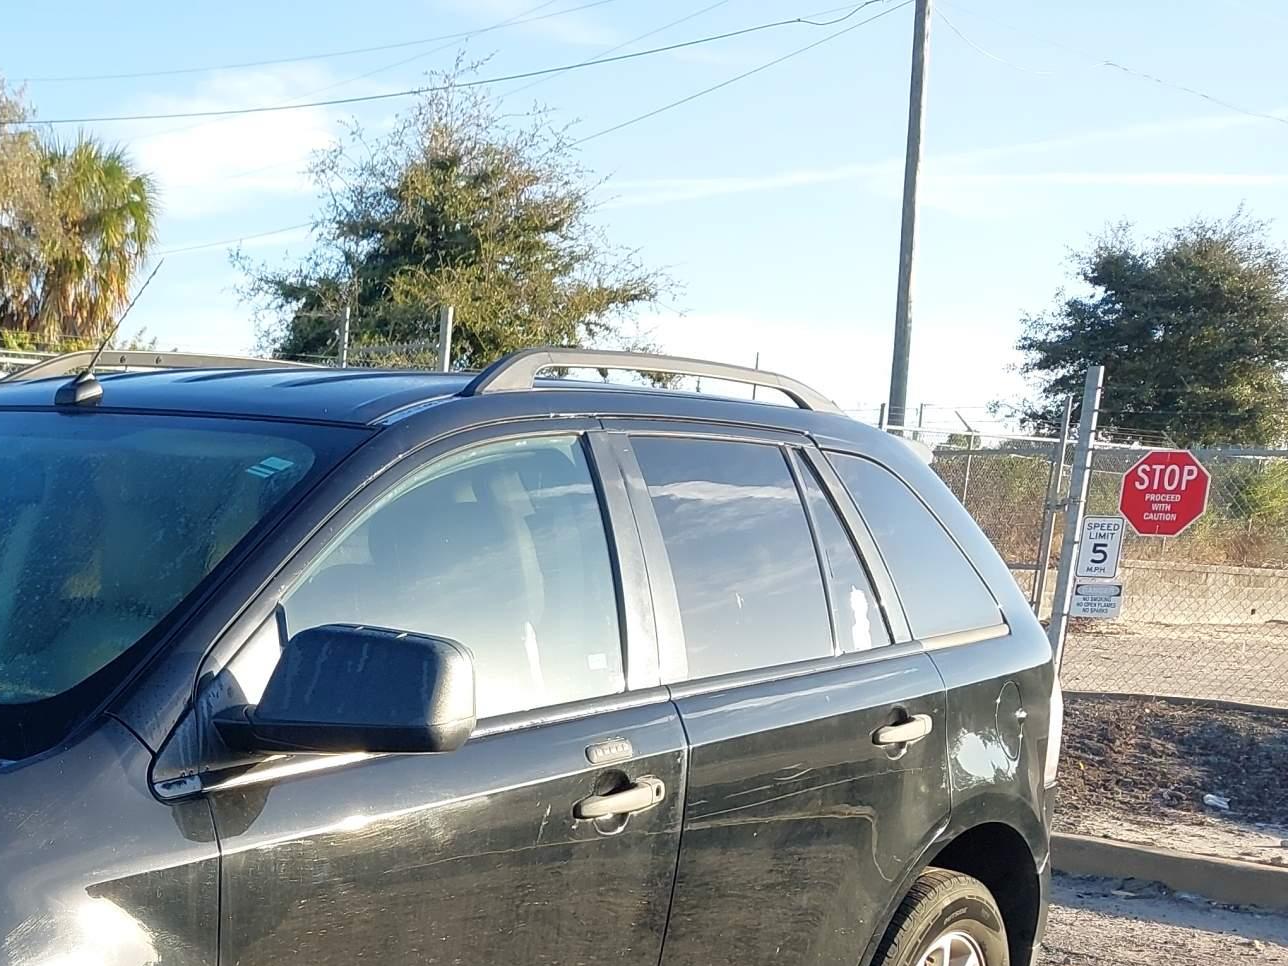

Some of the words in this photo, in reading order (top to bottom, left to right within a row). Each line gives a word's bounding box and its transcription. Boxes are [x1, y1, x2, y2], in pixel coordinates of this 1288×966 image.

[1134, 464, 1198, 491] STOP
[1144, 493, 1182, 502] PROCEED
[1151, 503, 1172, 512] WITH
[1143, 512, 1177, 521] CAUTION
[1086, 522, 1120, 532] SPEED
[1088, 532, 1116, 540] LIMIT
[1089, 543, 1109, 564] 5
